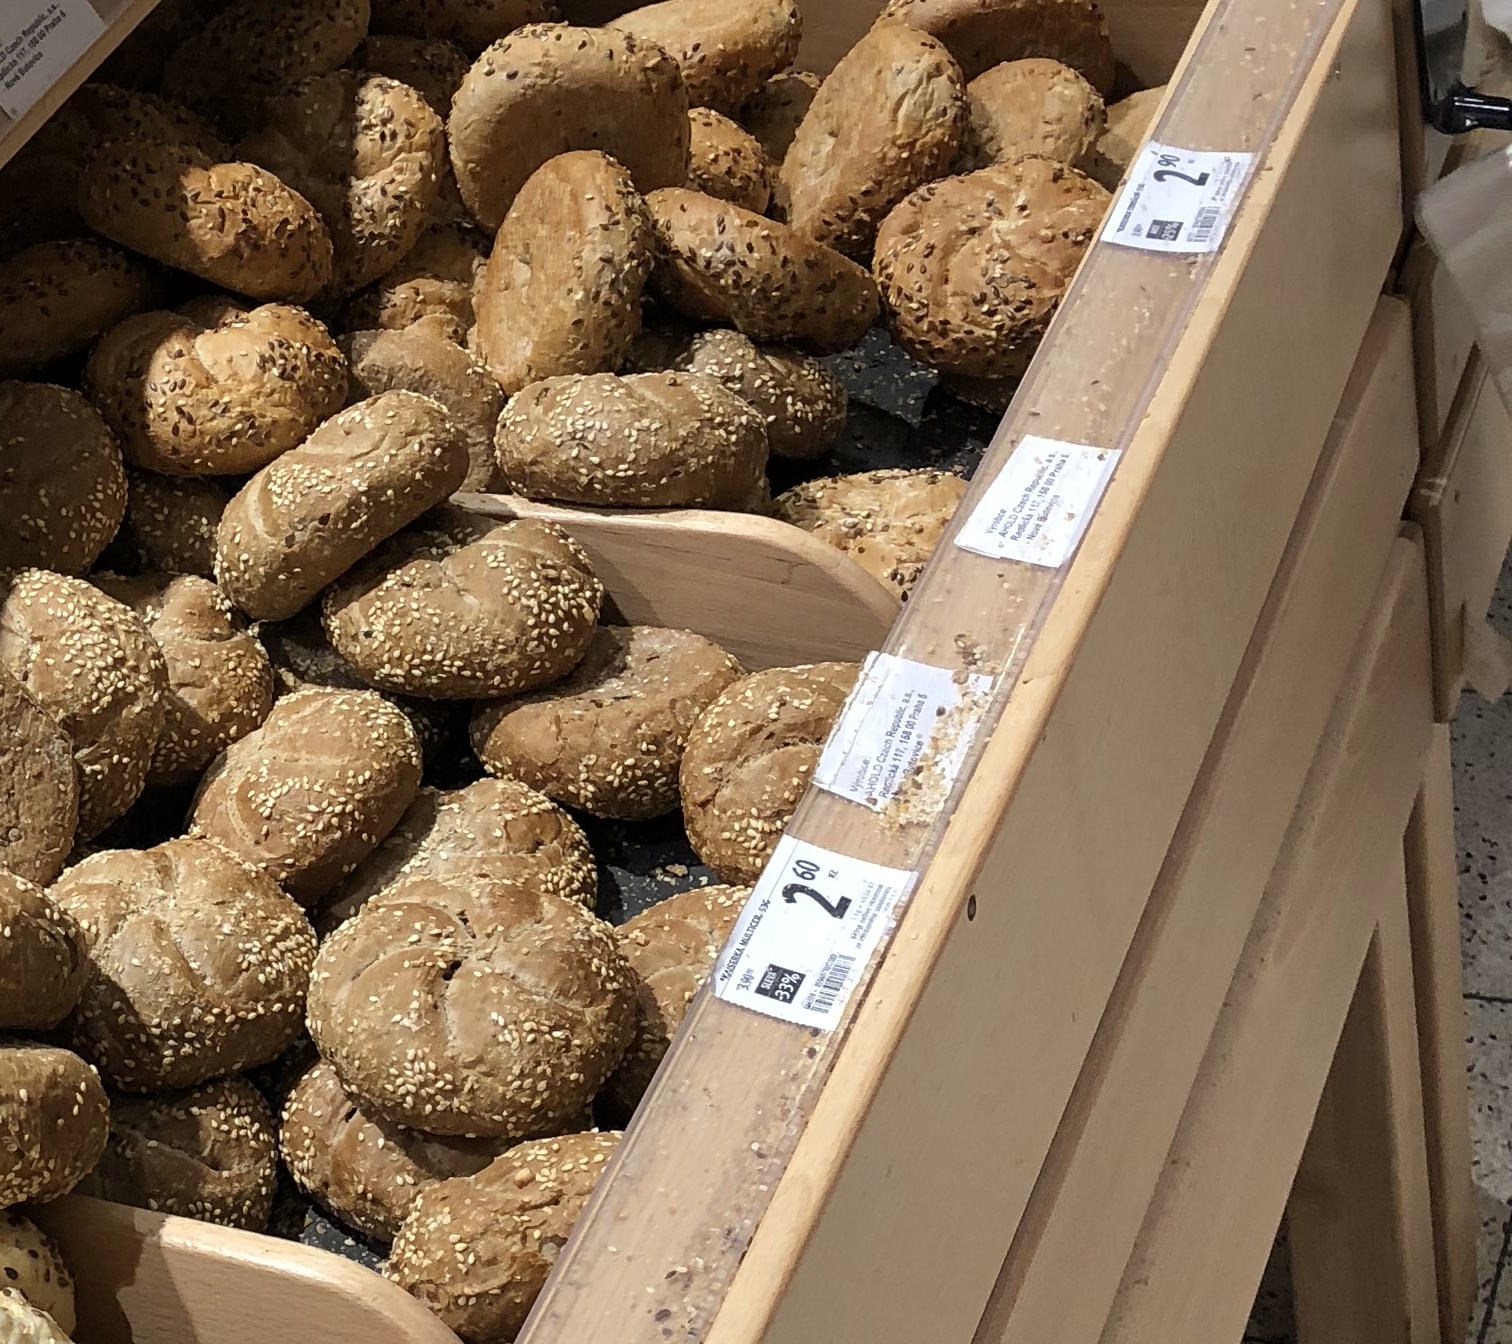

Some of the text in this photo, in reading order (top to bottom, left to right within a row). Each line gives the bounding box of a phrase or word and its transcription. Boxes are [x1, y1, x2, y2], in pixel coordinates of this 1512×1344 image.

[1157, 154, 1180, 168] 90
[1153, 169, 1210, 186] 2
[1048, 458, 1067, 477] Praha
[1043, 477, 1055, 486] 00
[998, 514, 1019, 538] AHOLD
[1012, 493, 1030, 514] Czech
[908, 699, 925, 721] Praha
[904, 720, 916, 730] 00
[862, 764, 884, 797] AHOLD
[875, 738, 893, 763] Czech
[884, 705, 909, 738] Republic,
[792, 859, 820, 881] 60
[781, 883, 852, 920] 2
[760, 969, 777, 990] SLEVA
[774, 973, 801, 1001] -33%
